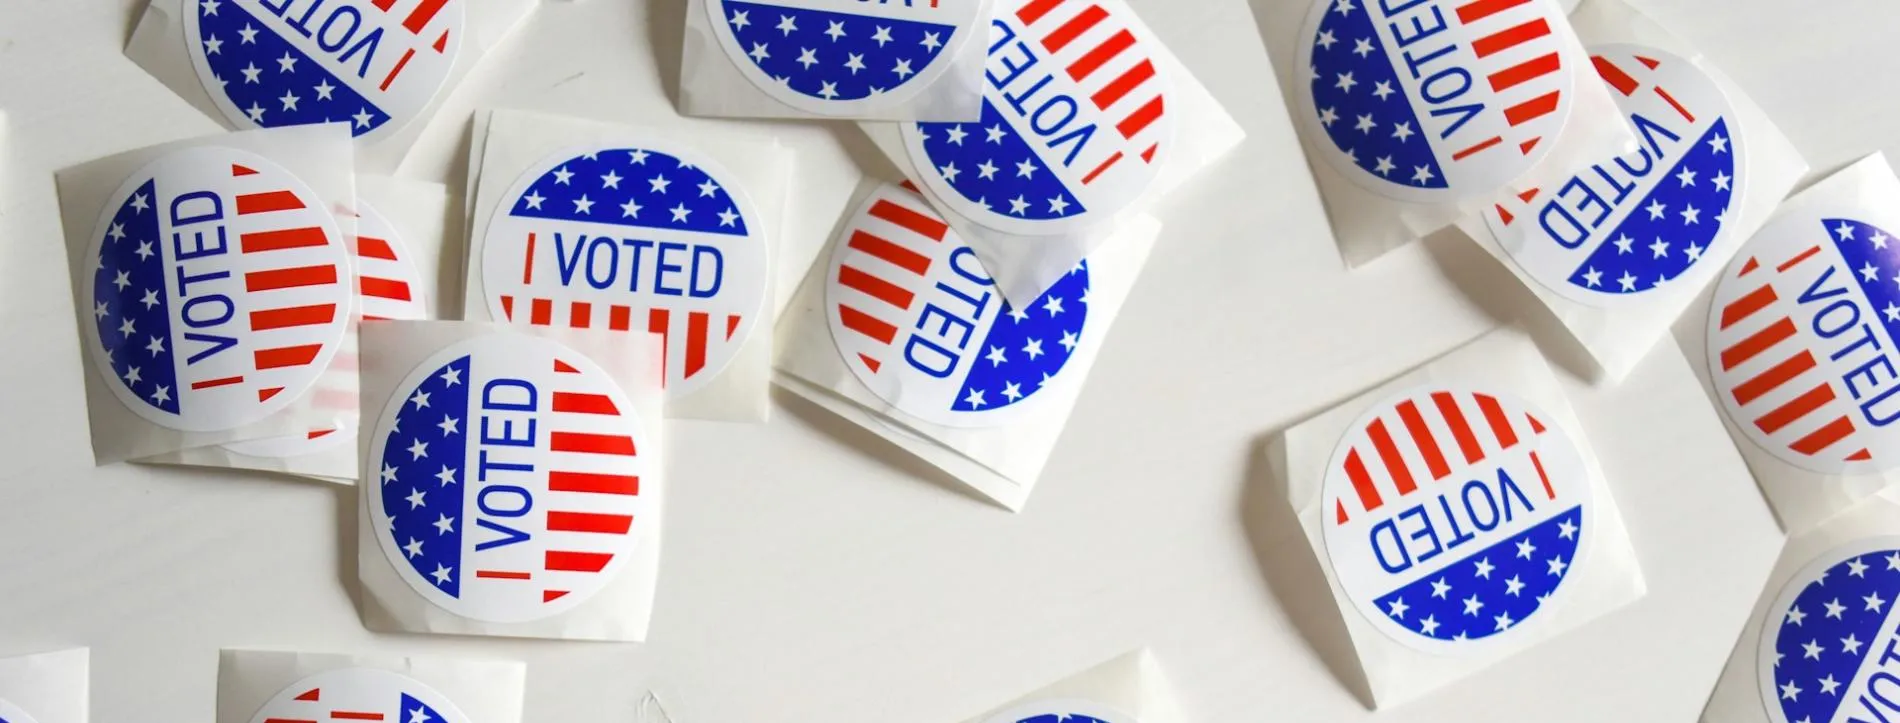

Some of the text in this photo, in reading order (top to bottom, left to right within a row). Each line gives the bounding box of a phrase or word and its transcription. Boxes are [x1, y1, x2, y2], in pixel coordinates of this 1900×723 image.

[257, 0, 417, 93] I VOT
[1452, 135, 1504, 162] I
[1653, 85, 1697, 124] I
[1080, 150, 1125, 186] I
[170, 189, 245, 392] I VOTED
[522, 231, 725, 300] I VOTED
[903, 245, 996, 381] OTED
[1775, 244, 1900, 428] I VOTED
[474, 377, 540, 581] I VOTED
[1368, 449, 1557, 576] I VOTED
